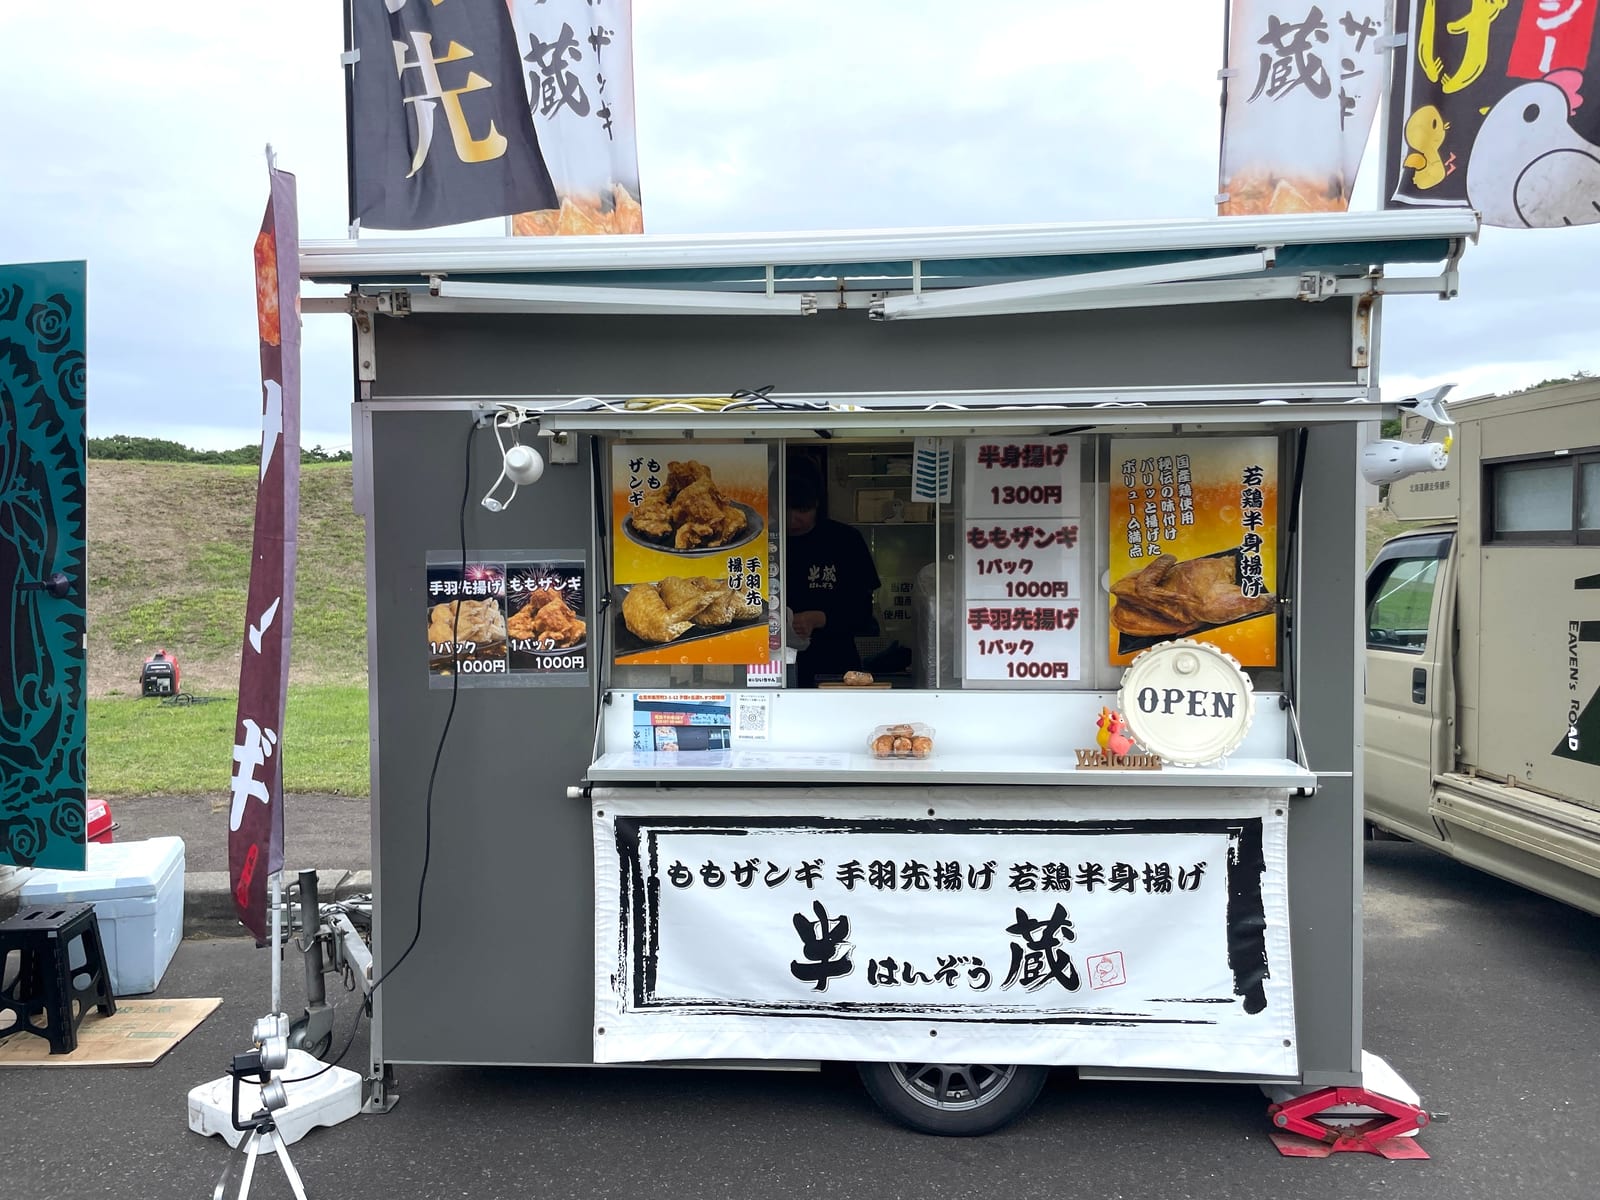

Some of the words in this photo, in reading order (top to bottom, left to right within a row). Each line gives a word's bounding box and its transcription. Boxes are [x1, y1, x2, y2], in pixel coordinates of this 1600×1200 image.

[392, 31, 508, 179] 先
[977, 444, 1069, 469] 半身揚げ
[628, 458, 644, 507] ザンギ
[647, 459, 661, 490] もも
[1176, 455, 1194, 525] 国産鶏使用
[991, 485, 1063, 504] 1300円
[1122, 460, 1143, 558] ボリューム満点
[1158, 456, 1177, 541] 秘伝の味付け
[967, 525, 1079, 549] ももザンギ
[1241, 465, 1264, 598] 若鶏半身揚げ
[429, 580, 502, 596] 手羽先揚げ
[510, 576, 582, 592] ももザンギ
[728, 558, 743, 591] 揚げ
[745, 557, 762, 606] 手羽先
[1005, 581, 1069, 597] 1000円
[968, 607, 1079, 631] 手羽先揚げ
[456, 659, 506, 673] 1000円
[535, 656, 585, 669] 1000円
[1007, 662, 1069, 678] 1000円
[1137, 687, 1237, 718] OPEN
[1568, 699, 1580, 752] ROAD
[667, 857, 825, 889] ももザンギ
[836, 859, 998, 892] 手羽先揚げ
[1008, 860, 1208, 893] 若鶏半身揚げ
[867, 955, 992, 990] はんぞう
[1000, 902, 1081, 993] 蔵
